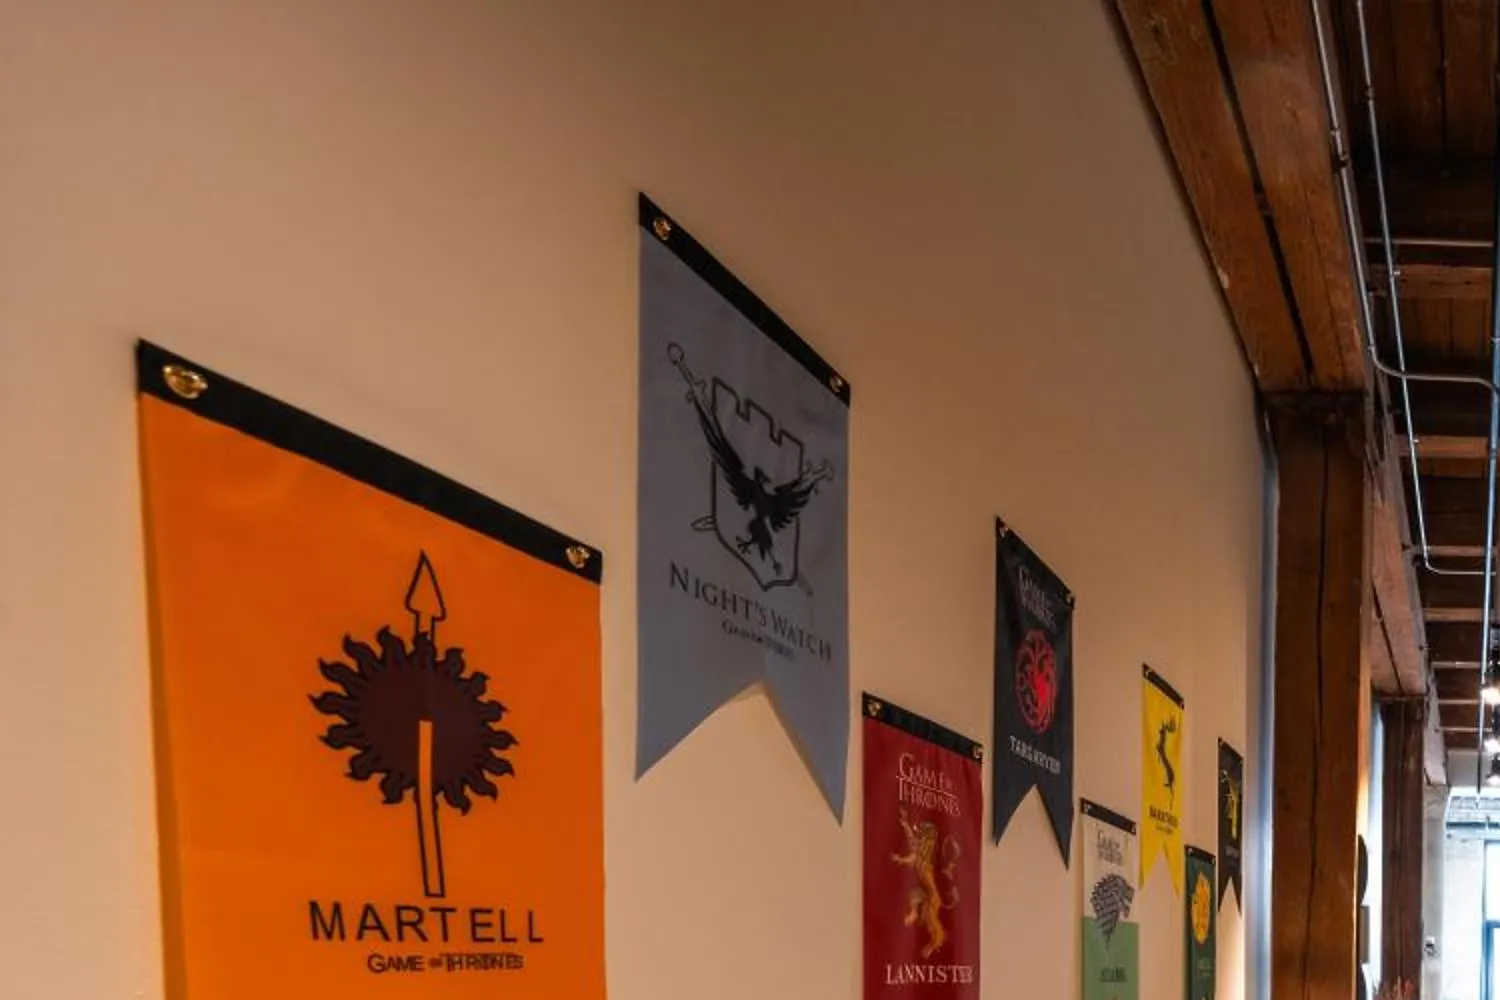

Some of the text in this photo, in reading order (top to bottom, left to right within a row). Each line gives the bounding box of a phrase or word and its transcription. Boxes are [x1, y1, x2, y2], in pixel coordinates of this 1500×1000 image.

[669, 560, 767, 627] NIGHT'S
[771, 609, 832, 662] WATCH
[308, 900, 544, 943] MARTELL
[367, 953, 425, 973] GAME
